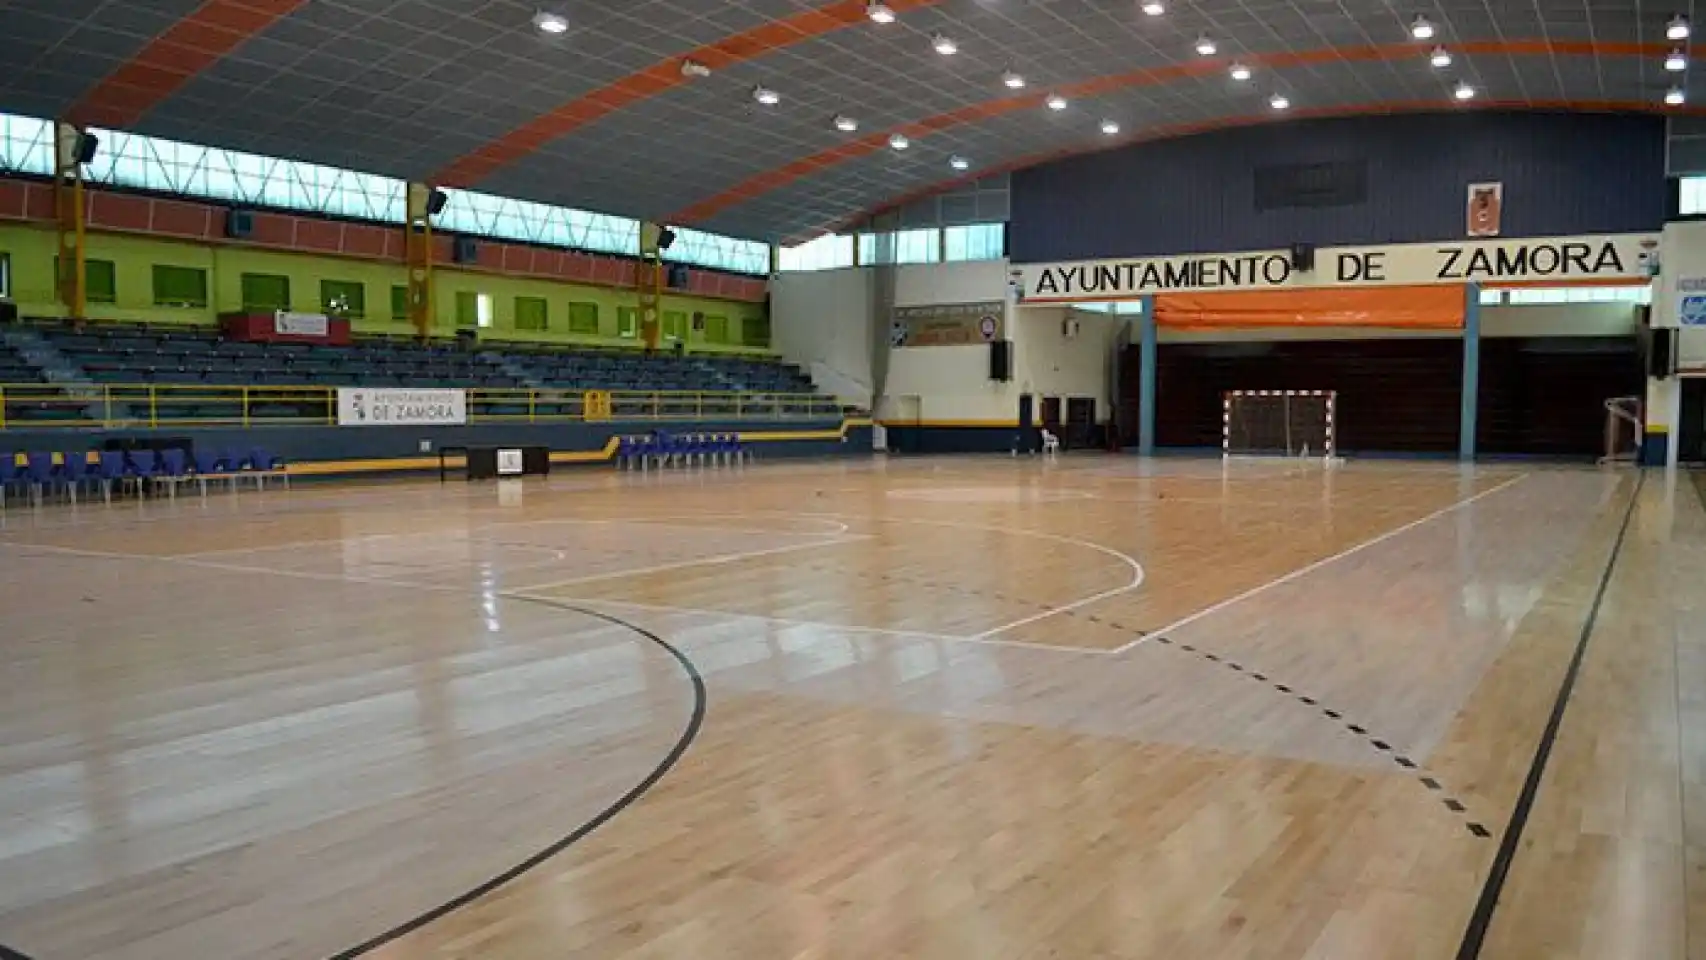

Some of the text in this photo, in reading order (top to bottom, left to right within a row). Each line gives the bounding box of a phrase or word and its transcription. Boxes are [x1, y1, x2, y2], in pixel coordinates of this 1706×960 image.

[1036, 242, 1624, 294] AYUNTAMIENTO DE ZAMORA
[396, 403, 455, 420] ZAMORA
